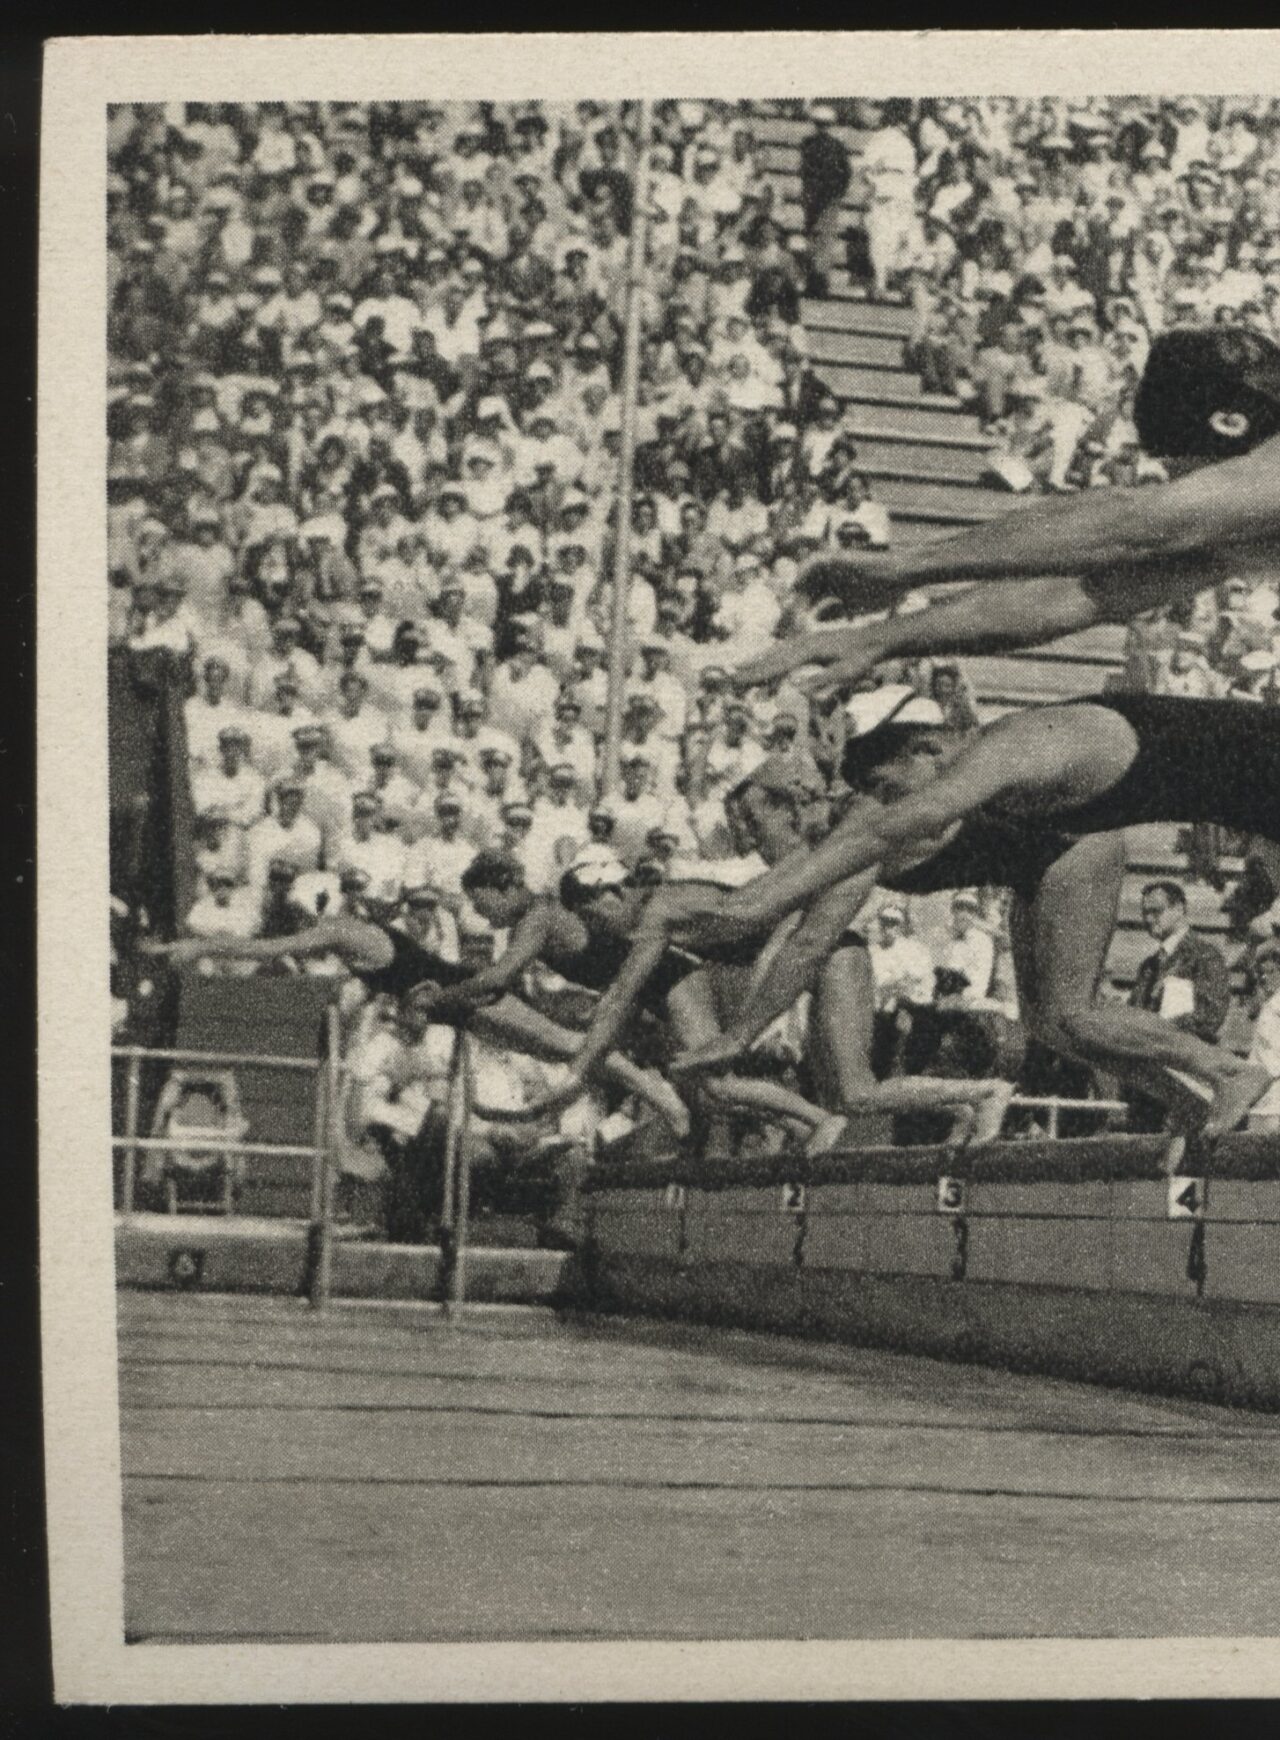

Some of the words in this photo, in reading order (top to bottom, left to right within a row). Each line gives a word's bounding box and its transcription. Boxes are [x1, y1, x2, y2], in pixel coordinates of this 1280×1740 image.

[788, 1183, 800, 1207] 2
[944, 1182, 961, 1208] 3
[1176, 1181, 1200, 1213] 4
